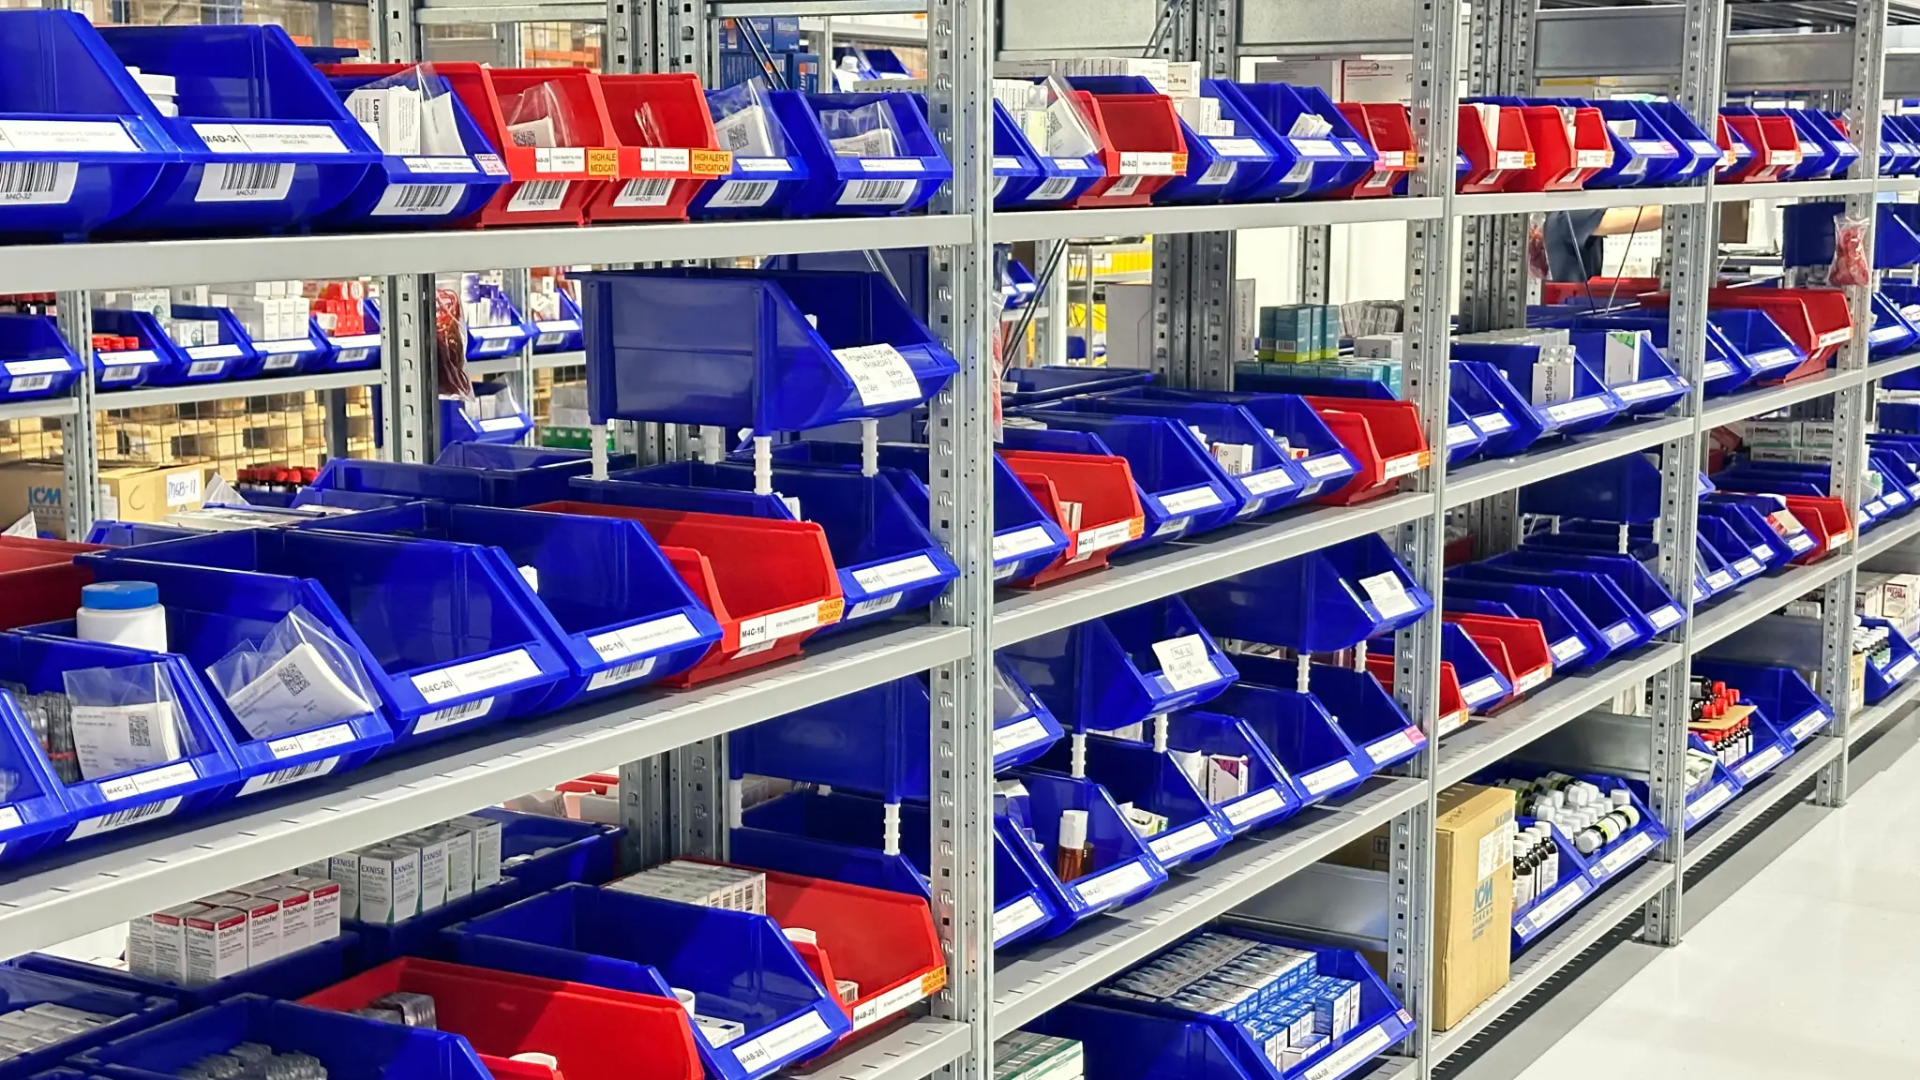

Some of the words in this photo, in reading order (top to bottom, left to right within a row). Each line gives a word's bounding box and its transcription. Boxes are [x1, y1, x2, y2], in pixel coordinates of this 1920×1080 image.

[203, 135, 241, 144] M4D-31
[694, 153, 710, 162] HIGH
[710, 153, 729, 162] ALERT
[694, 164, 730, 172] MEDICATION
[742, 625, 765, 639] M4C-18
[420, 680, 453, 695] M4C-20
[106, 783, 134, 795] M4C-22
[424, 849, 442, 862] EXNISE
[333, 858, 355, 869] EXNISE
[394, 861, 414, 875] EXNISE
[361, 864, 385, 876] EXNISE
[313, 895, 338, 907] Maltofer
[1474, 878, 1493, 912] ICM
[283, 905, 308, 917] Maltofer
[251, 915, 278, 927] Maltofer
[218, 926, 245, 939] Maltofer
